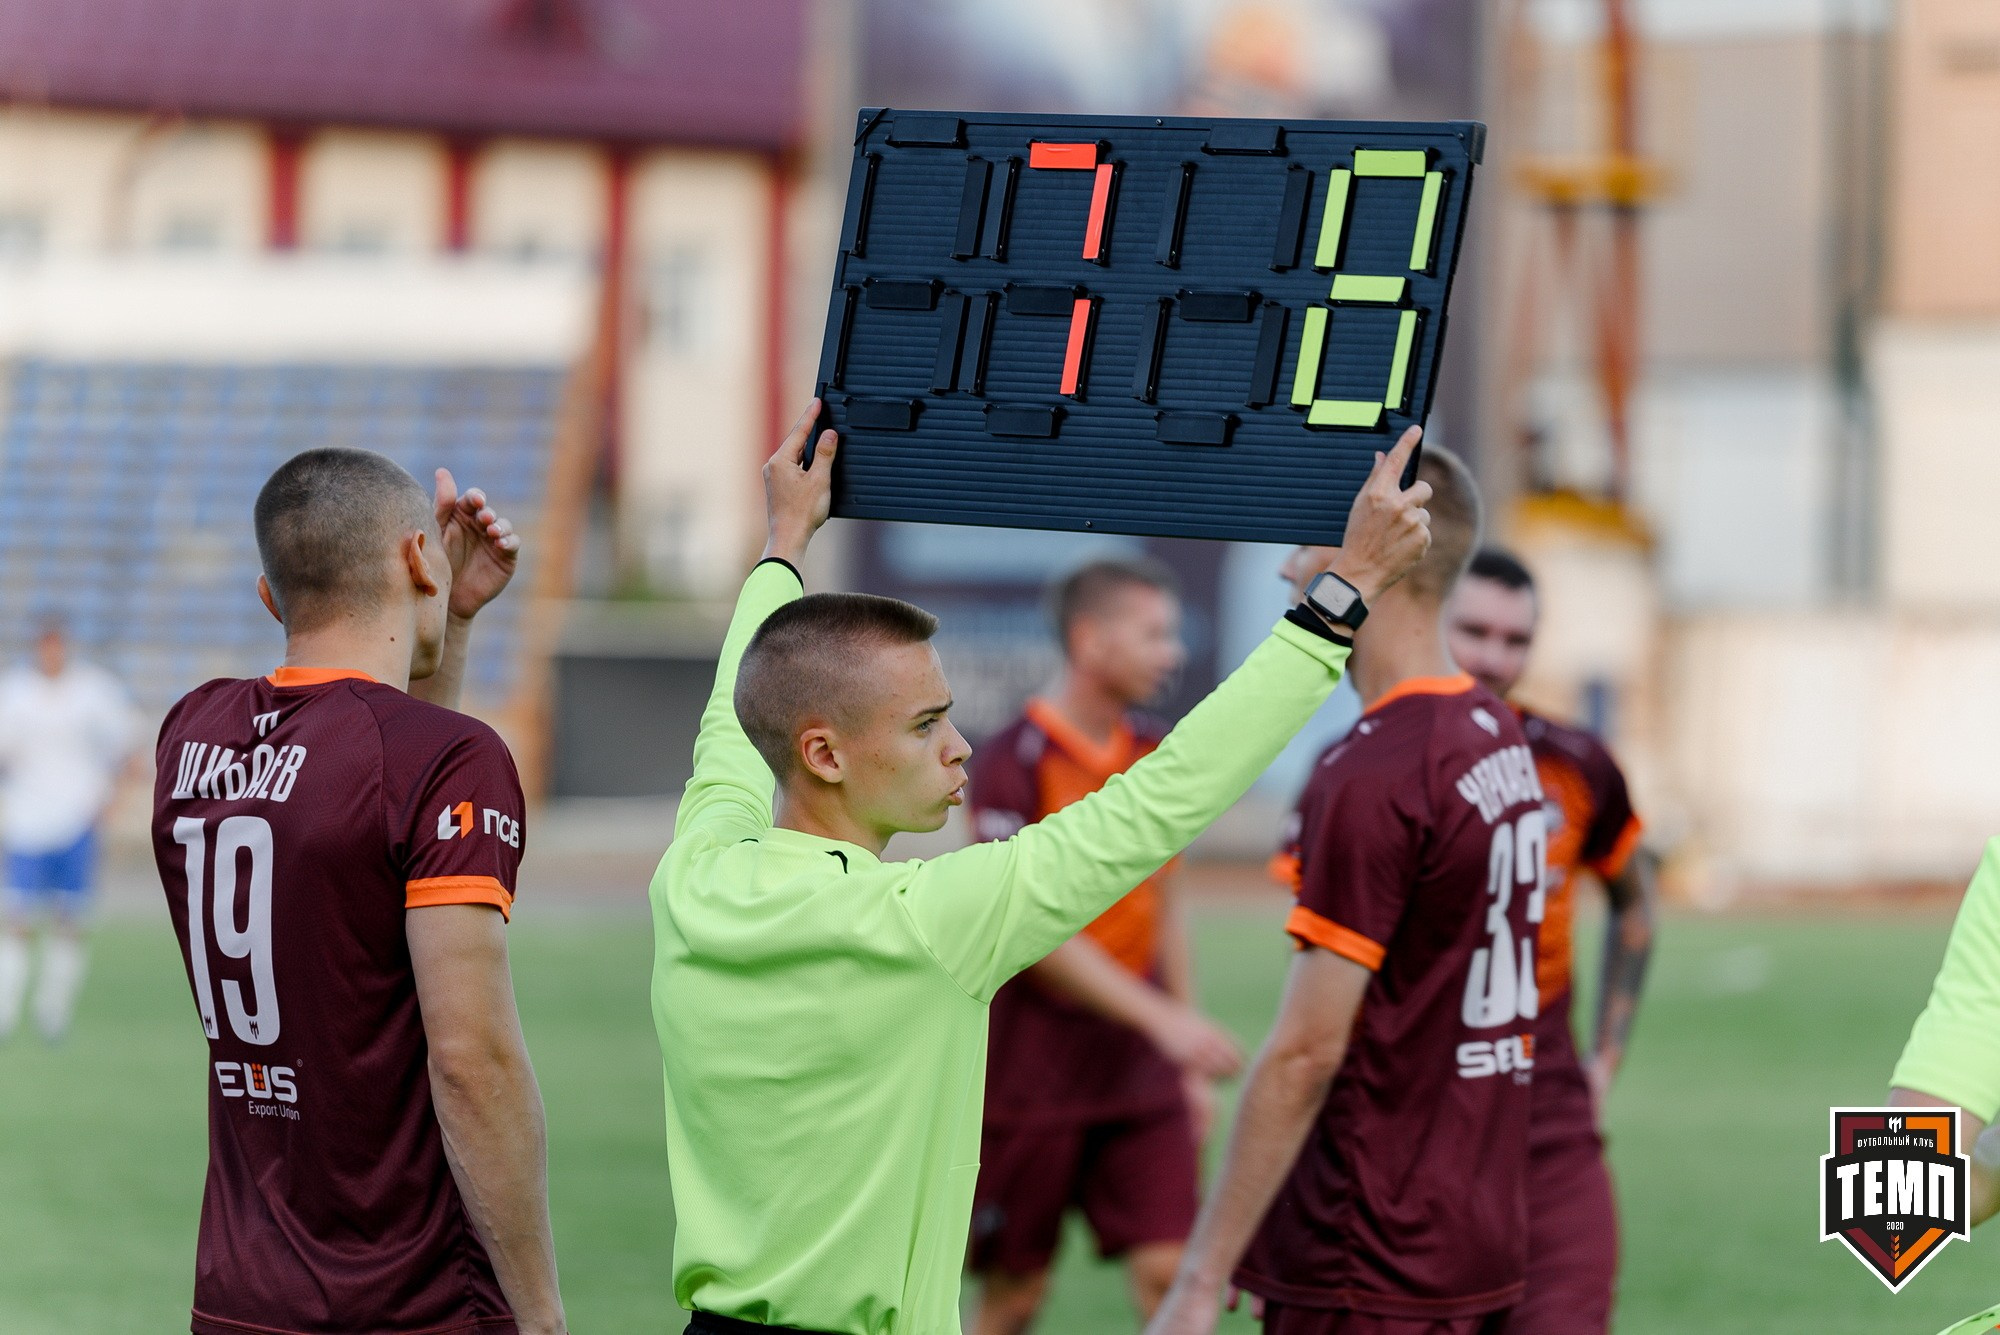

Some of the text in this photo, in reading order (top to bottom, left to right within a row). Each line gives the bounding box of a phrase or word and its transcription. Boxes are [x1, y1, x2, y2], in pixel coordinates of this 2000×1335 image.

[1029, 142, 1443, 427] 7 8
[483, 808, 519, 849] ПСБ
[173, 816, 280, 1046] 19
[1462, 811, 1547, 1029] 33
[215, 1061, 298, 1104] EUS
[248, 1101, 300, 1120] Export Union
